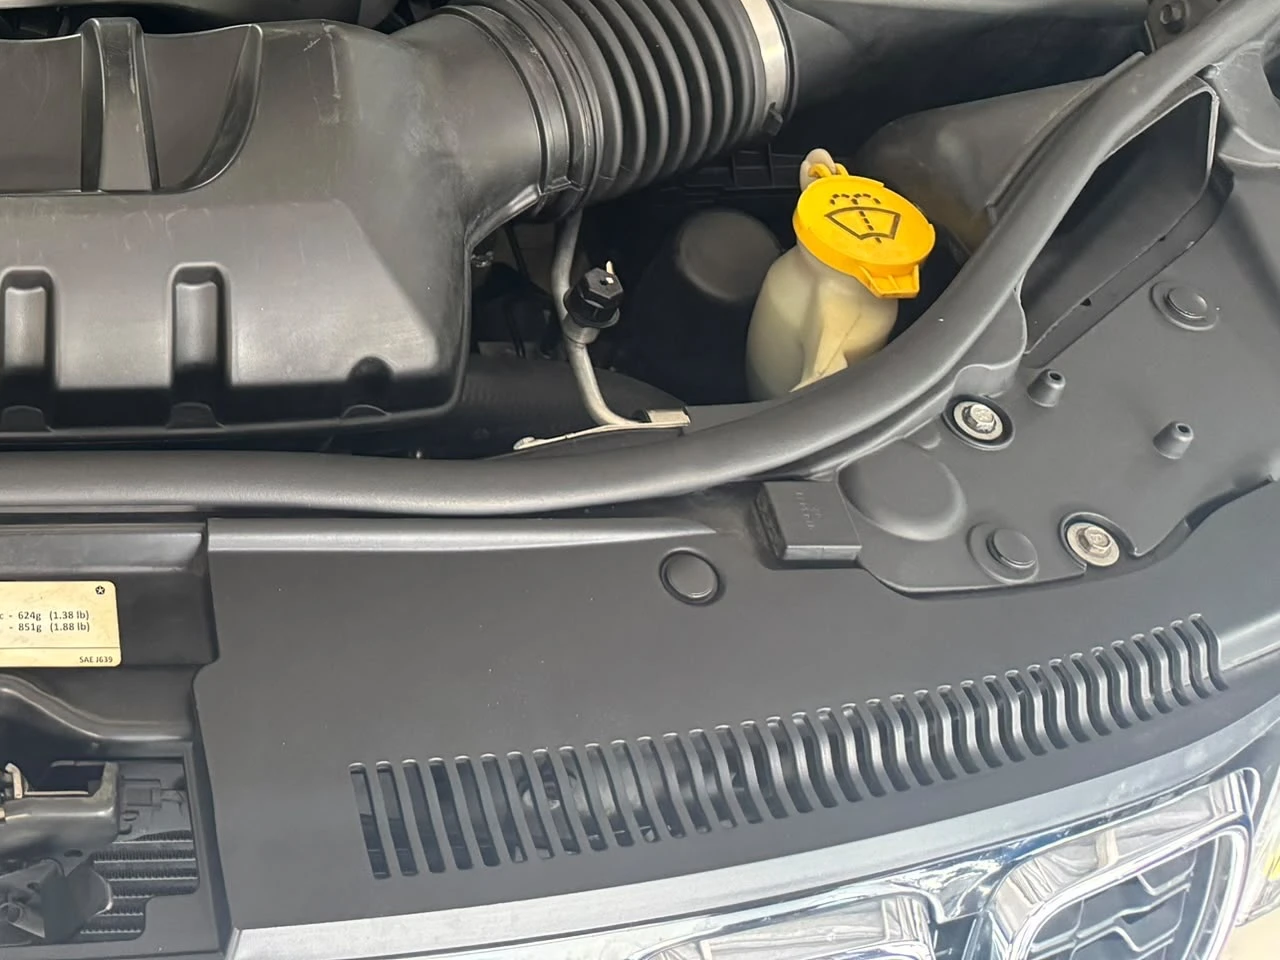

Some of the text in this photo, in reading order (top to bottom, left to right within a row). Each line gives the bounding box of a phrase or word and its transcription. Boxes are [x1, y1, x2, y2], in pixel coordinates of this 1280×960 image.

[18, 611, 42, 621] 624g
[49, 611, 74, 620] (1.38
[76, 611, 90, 620] lb)
[18, 623, 42, 633] 851g
[50, 623, 75, 632] (1.88
[77, 623, 90, 632] lb)
